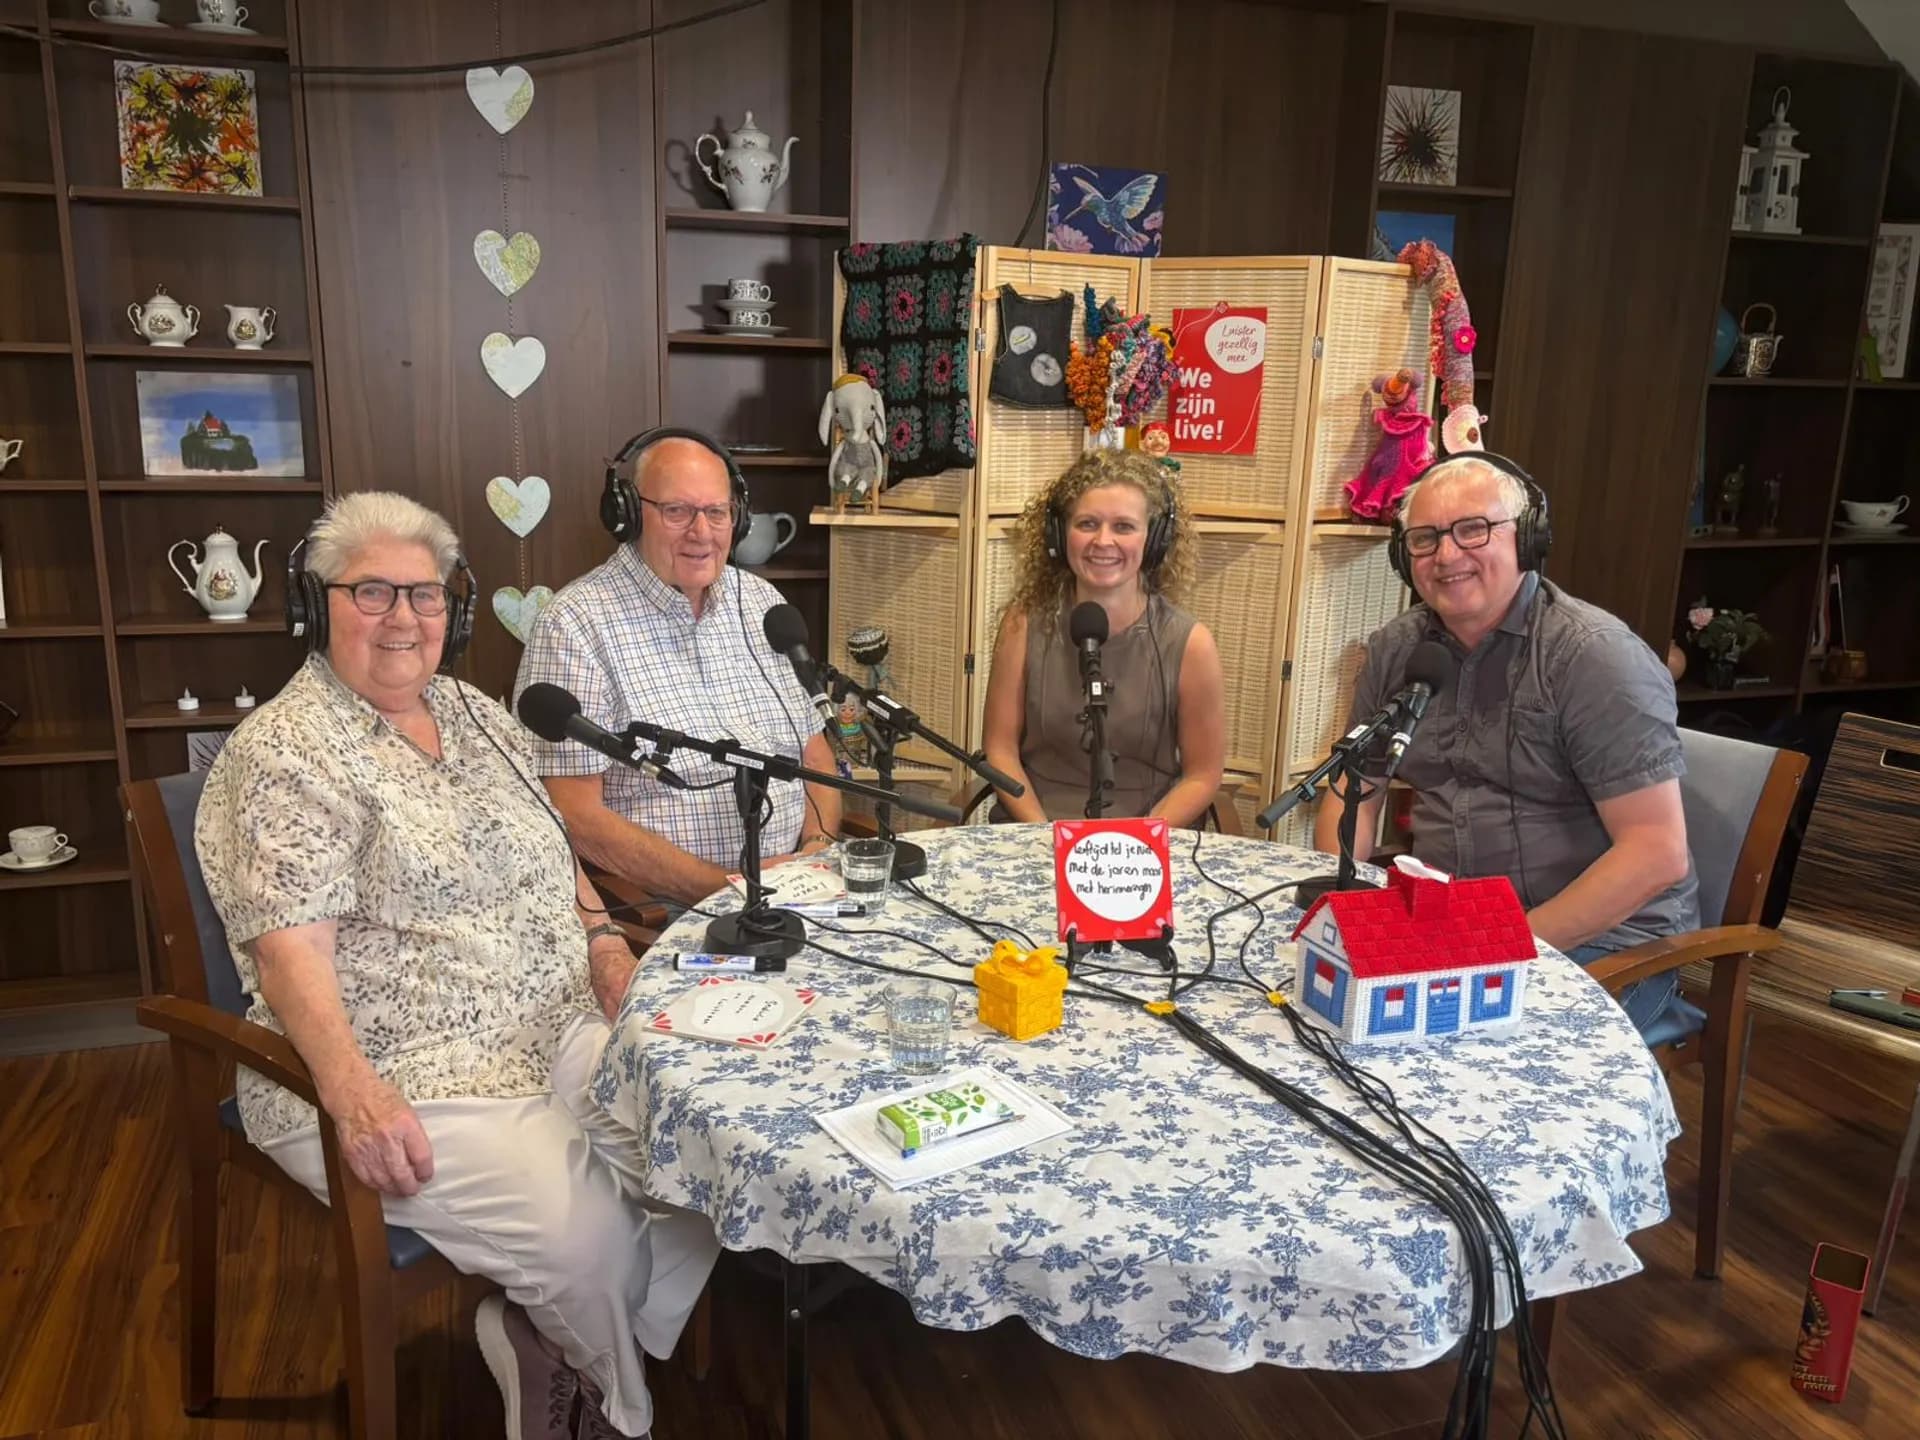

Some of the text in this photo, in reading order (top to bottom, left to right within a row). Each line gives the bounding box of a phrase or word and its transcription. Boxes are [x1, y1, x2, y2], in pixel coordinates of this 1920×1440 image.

[1221, 324, 1257, 338] Luister
[1217, 337, 1258, 355] gezellig
[1179, 368, 1212, 388] We
[1176, 394, 1215, 419] zijn
[1174, 418, 1225, 441] live!
[1090, 863, 1105, 877] de
[1107, 864, 1139, 878] jaren
